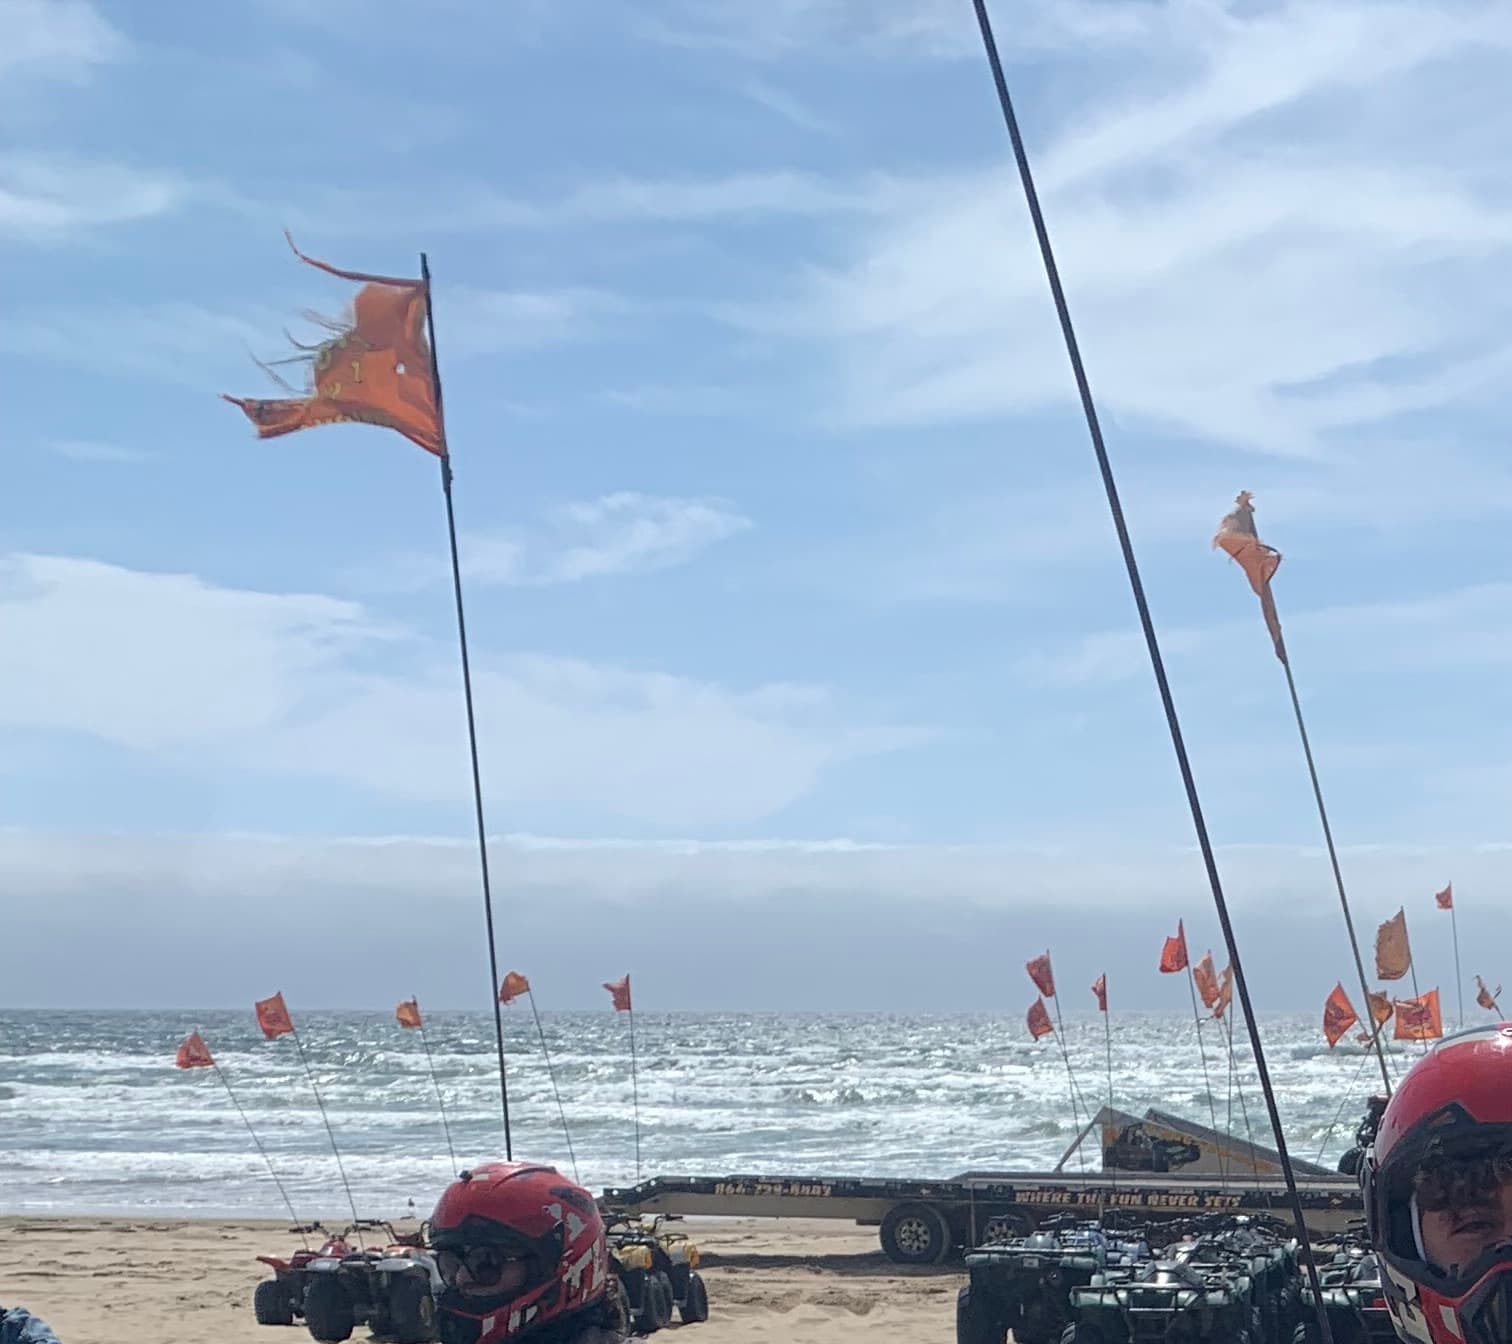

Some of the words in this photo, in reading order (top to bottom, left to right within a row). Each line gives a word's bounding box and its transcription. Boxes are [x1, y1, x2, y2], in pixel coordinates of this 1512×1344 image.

[1015, 1191, 1071, 1203] WHERE
[1109, 1193, 1142, 1205] FUN
[1147, 1194, 1199, 1207] NEVER
[1204, 1196, 1242, 1207] SETS
